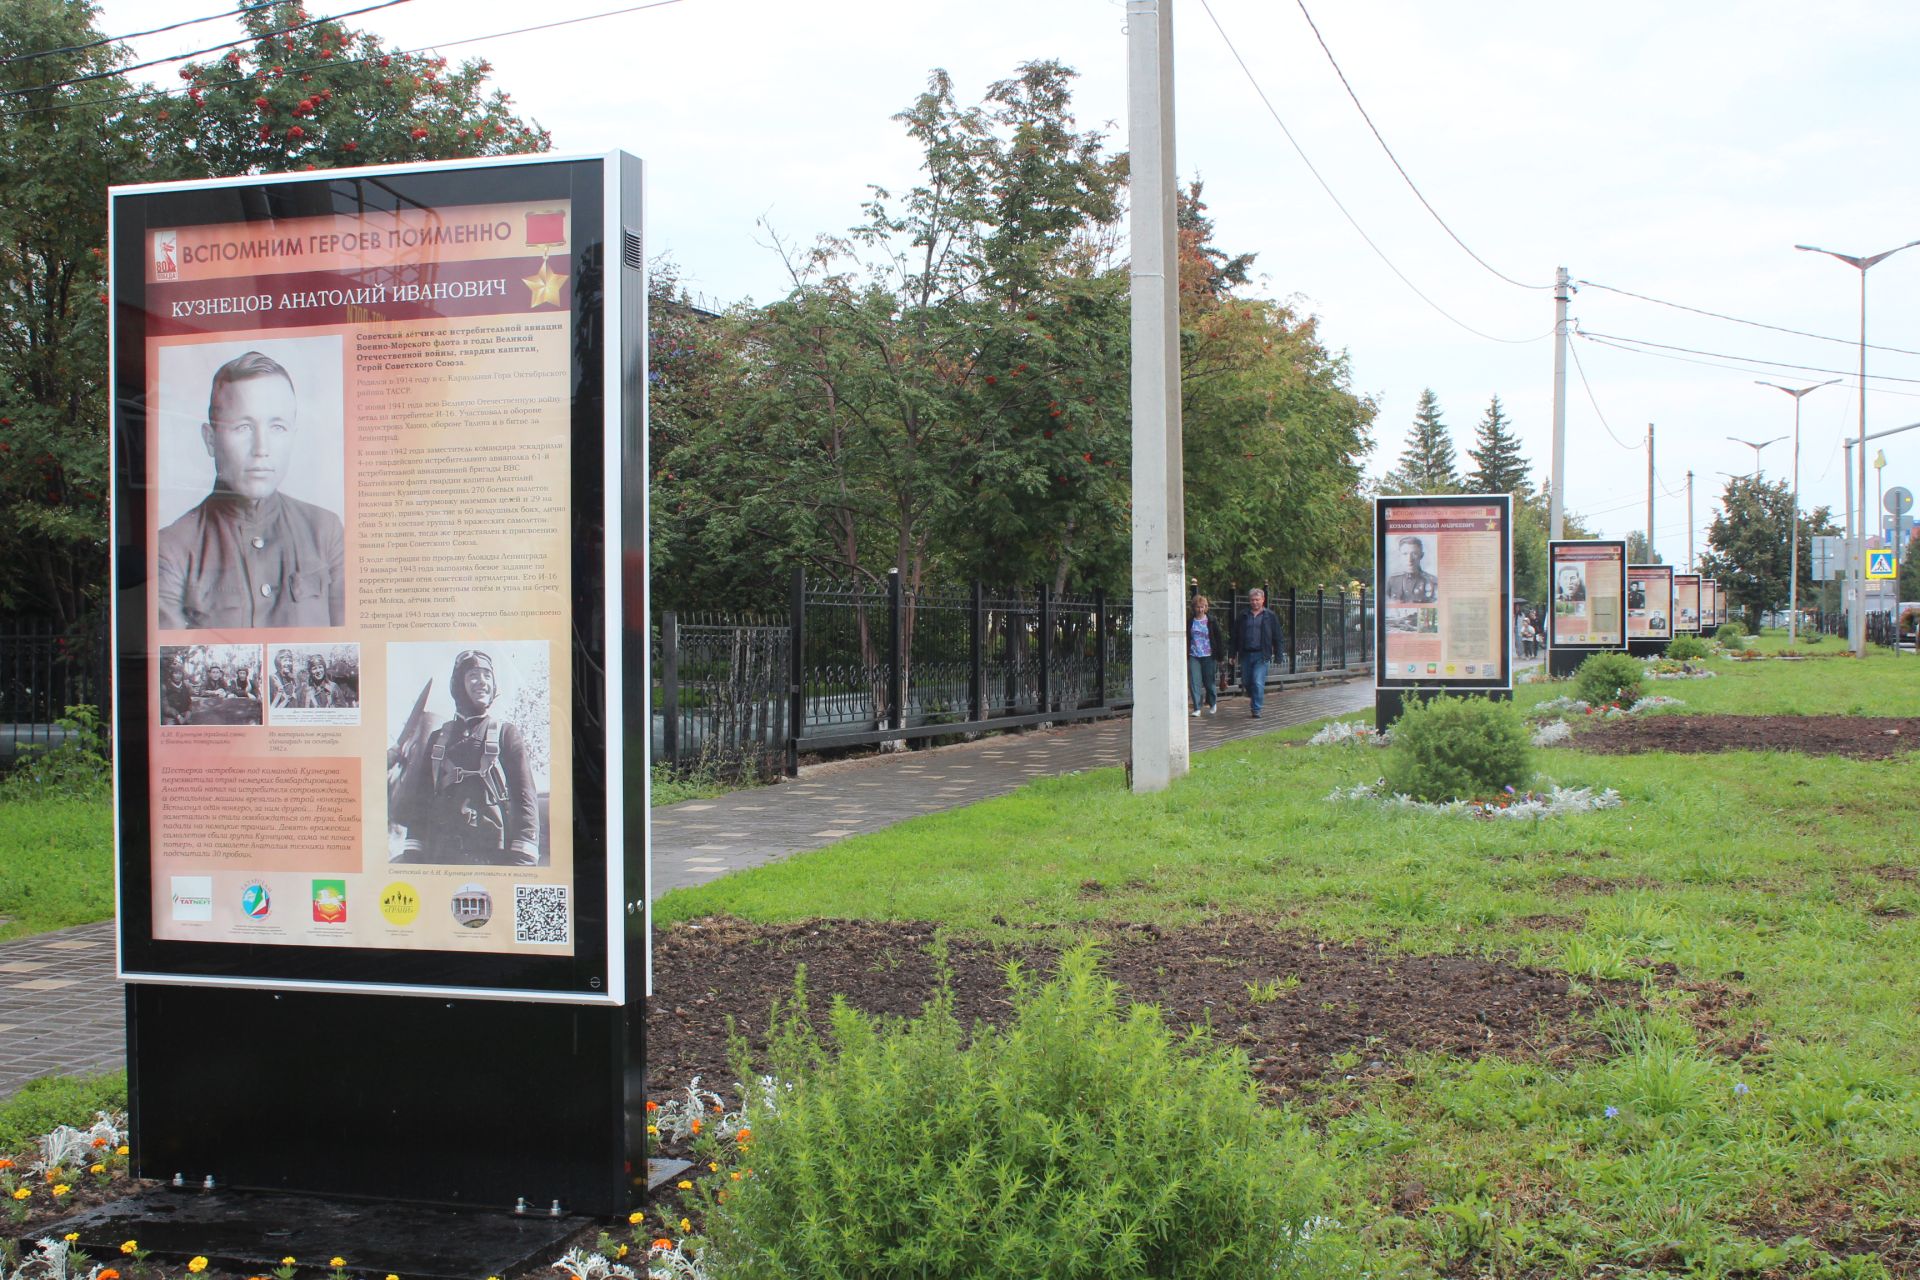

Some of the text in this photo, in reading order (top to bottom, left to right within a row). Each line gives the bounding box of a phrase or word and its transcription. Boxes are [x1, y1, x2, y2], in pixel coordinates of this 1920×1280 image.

[182, 221, 512, 264] ВСПОМНИМ ГЕРОЕВ ПОИМЕННО
[172, 278, 507, 318] КУЗНЕЦОВ АНАТОЛИЙ ИВАНОВИЧ
